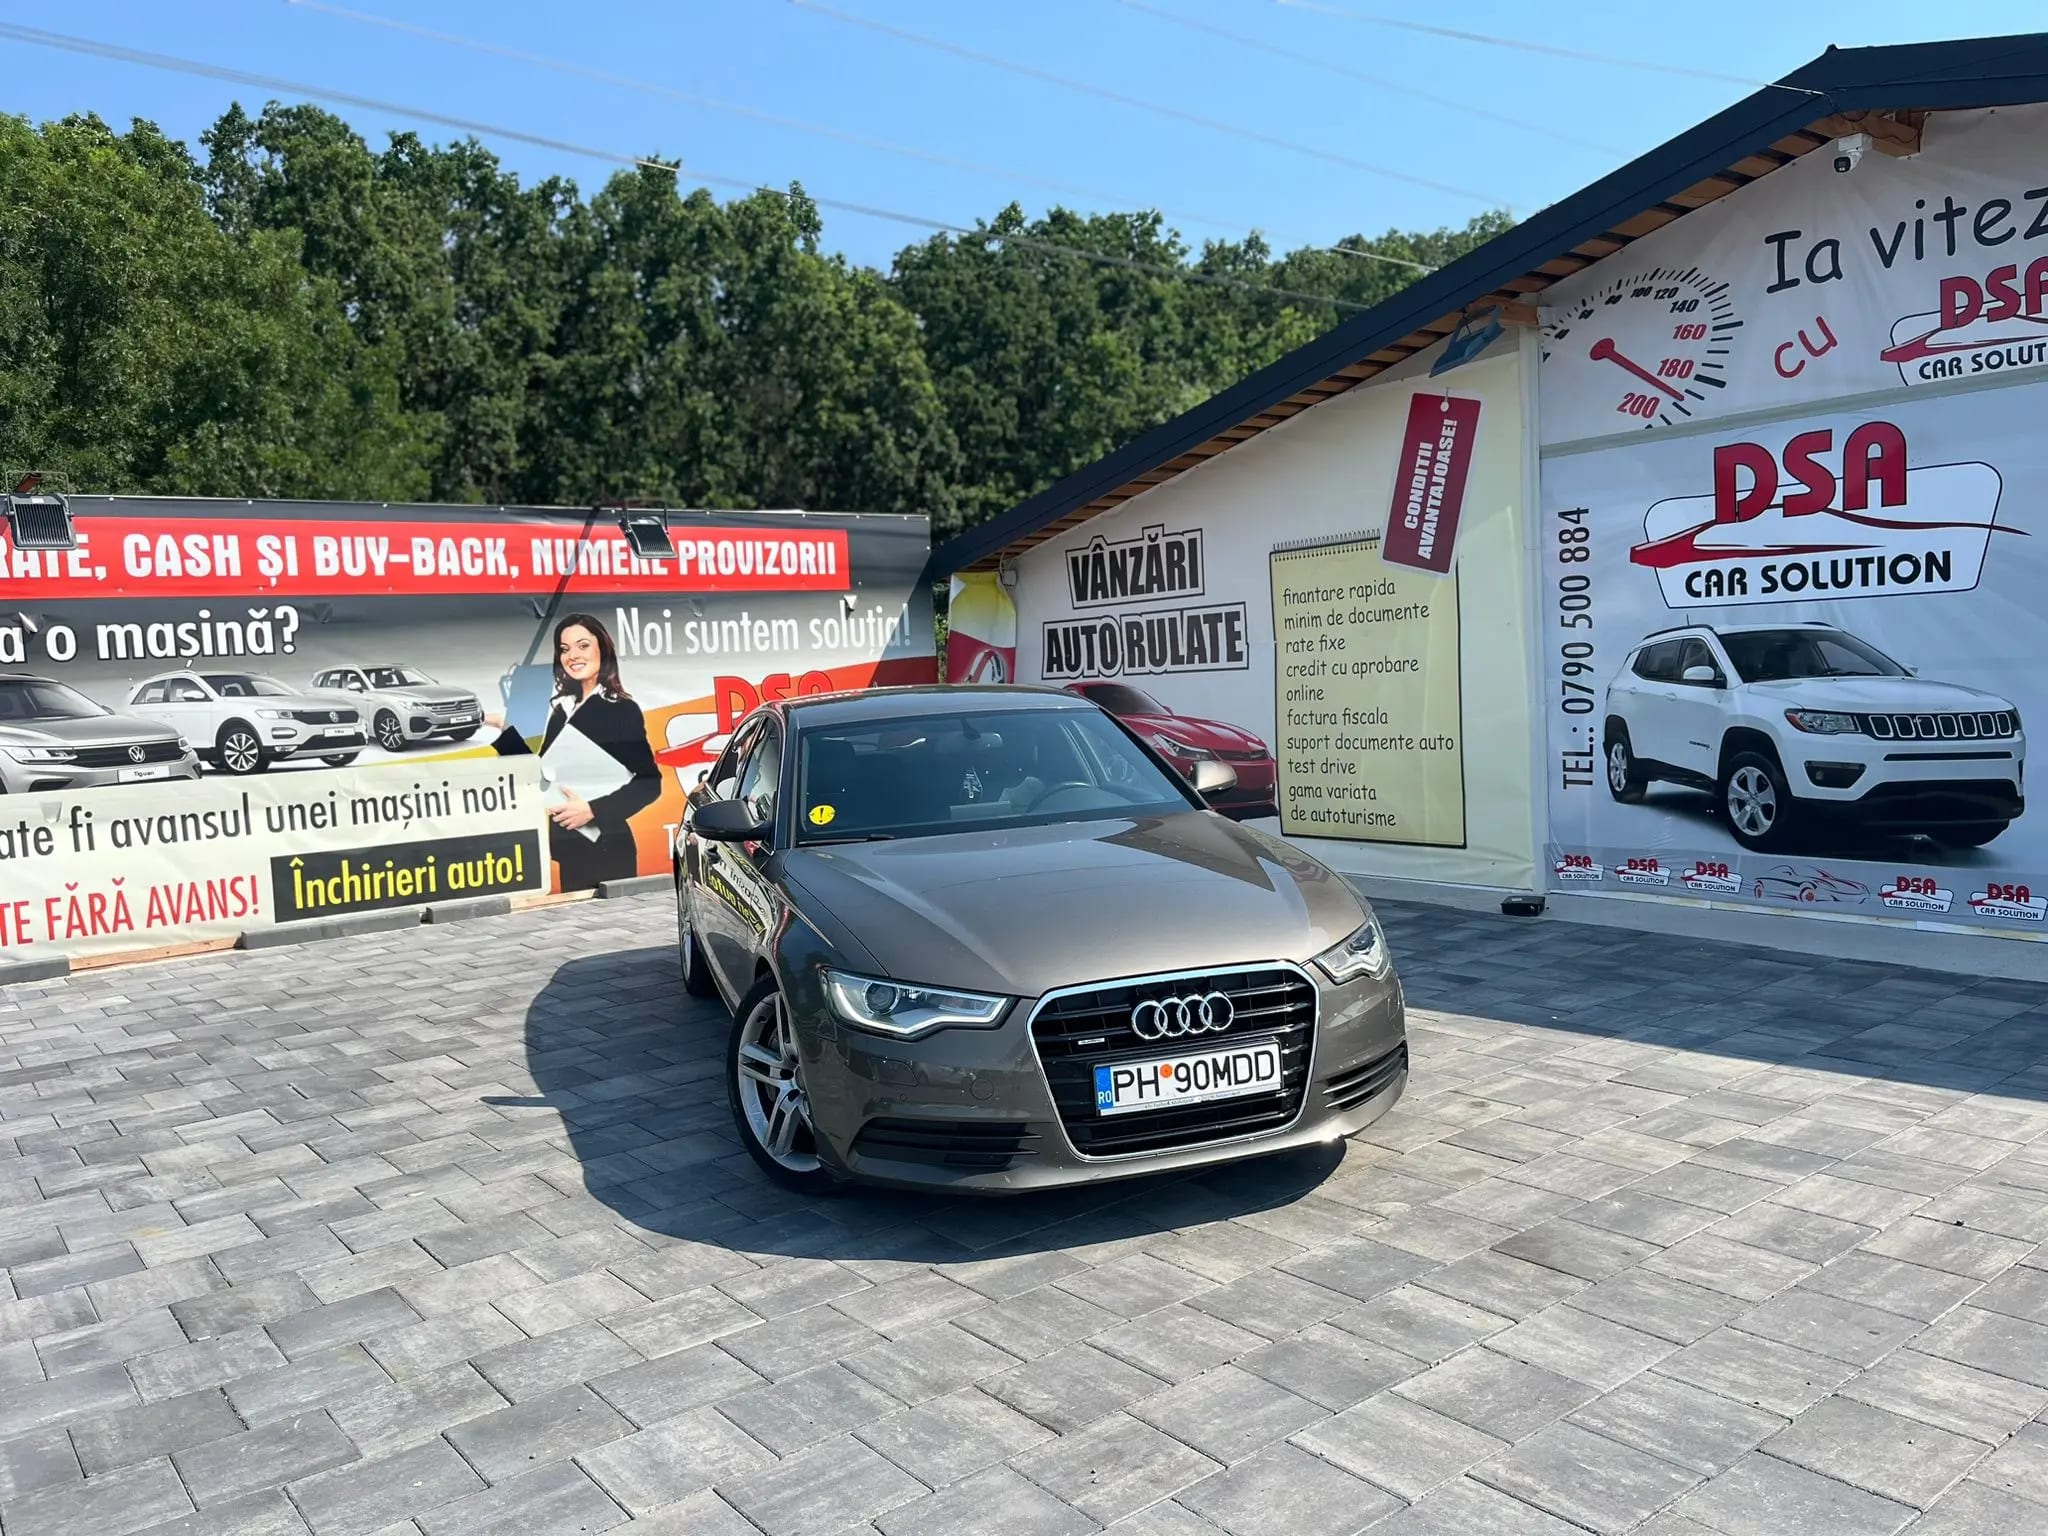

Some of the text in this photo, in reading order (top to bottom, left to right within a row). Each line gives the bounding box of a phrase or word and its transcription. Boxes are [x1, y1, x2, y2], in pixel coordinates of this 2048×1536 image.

[1765, 230, 1843, 294] Ia
[1653, 287, 1679, 300] 120
[1669, 299, 1699, 313] 140
[1672, 324, 1707, 340] 160
[1773, 316, 1838, 379] cu
[1657, 358, 1694, 378] 180
[1919, 356, 1963, 380] CAR
[1616, 392, 1660, 418] 200
[1713, 421, 1907, 524] DSA
[1404, 441, 1433, 530] CONDITII
[1417, 418, 1457, 560] AVANTAJOASE!
[1557, 507, 1590, 564] 884
[123, 533, 242, 578] CASH
[313, 536, 519, 578] BUY-BACK,
[679, 540, 836, 575] PROVIZORII
[1070, 532, 1200, 602] VÂNZĂRI
[1685, 550, 1953, 599] CAR SOLUTION
[1283, 577, 1396, 607] finantare rapida
[1559, 575, 1593, 629] 500
[1284, 602, 1430, 630] minim de documente
[46, 624, 77, 662] o
[97, 604, 300, 668] mașină?
[616, 606, 672, 657] Noi
[685, 611, 800, 656] suntem
[1046, 611, 1244, 674] AUTO RULATE
[1286, 634, 1346, 653] rate fixe
[1286, 655, 1420, 680] credit cu aprobare
[1561, 641, 1595, 715] 0790
[1286, 684, 1325, 702] online
[1287, 707, 1388, 726] factura fiscala
[1287, 733, 1454, 754] suport documente auto
[1288, 757, 1357, 775] test drive
[1289, 784, 1377, 802] gama variata
[69, 805, 95, 853] fi
[110, 792, 252, 849] avansul
[265, 789, 338, 834] unei
[351, 780, 452, 831] mașini
[463, 773, 518, 816] noi!
[1291, 805, 1397, 827] de autoturisme
[1564, 854, 1593, 868] DSA
[1627, 858, 1658, 873] DSA
[1695, 861, 1729, 879] DSA
[289, 844, 524, 910] Închirieri auto!
[1896, 876, 1936, 895] DSA
[1987, 883, 2031, 903] DSA
[45, 876, 135, 941] FĂRĂ
[146, 875, 260, 928] AVANS!
[1906, 901, 1945, 911] SOLUTION
[1998, 908, 2039, 920] SOLUTION
[1112, 1066, 1161, 1102] PH
[1098, 1090, 1112, 1104] RO
